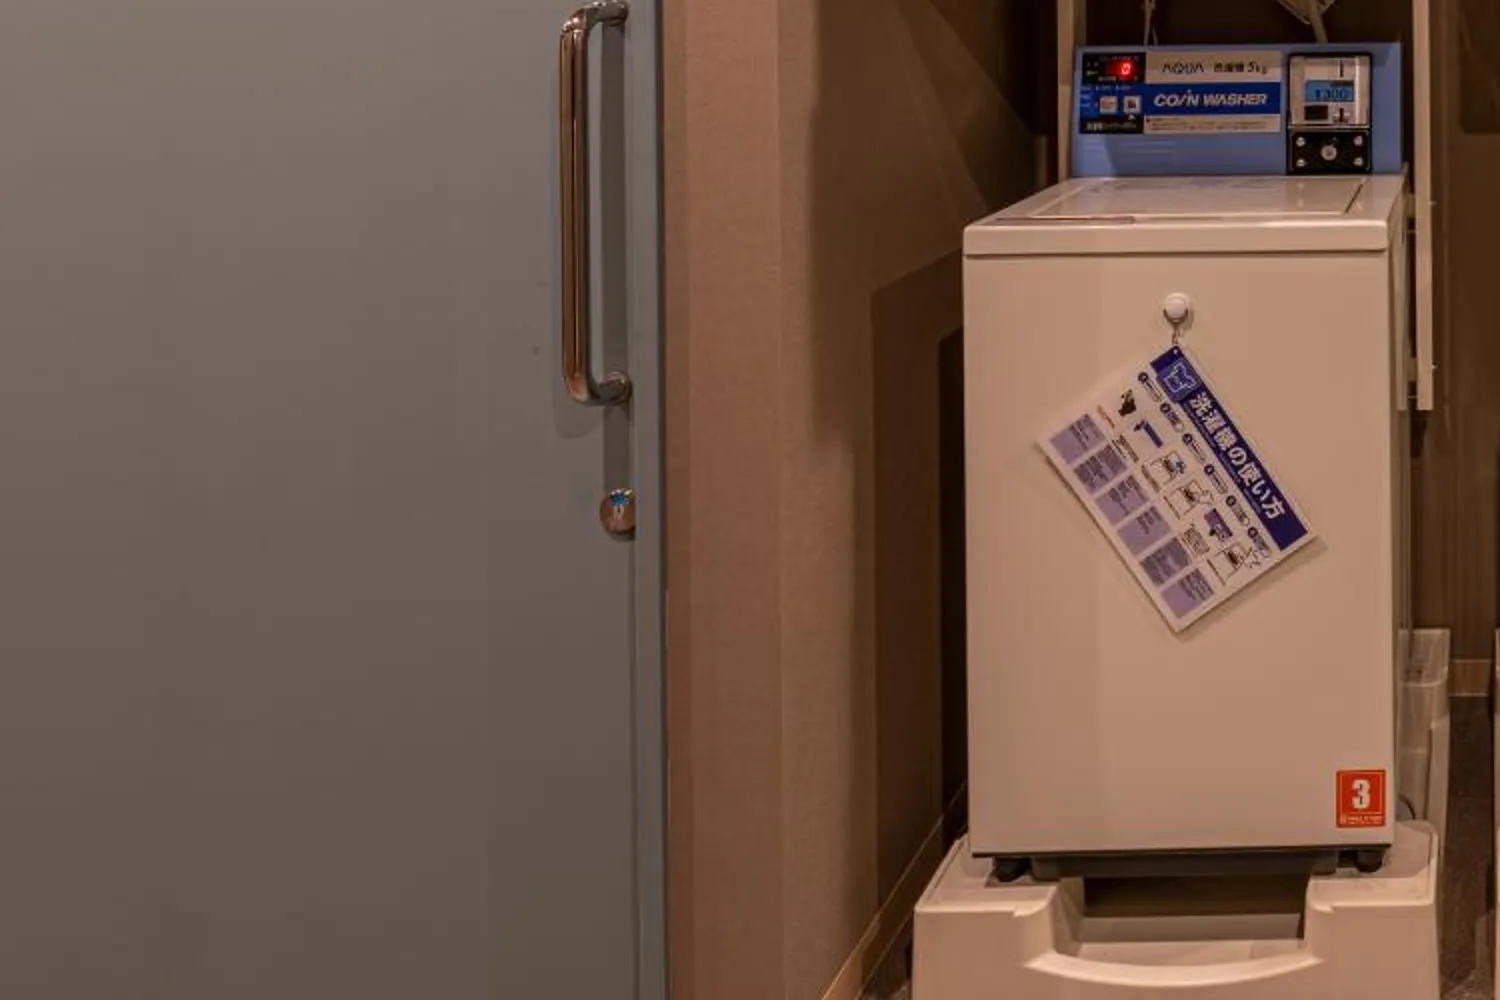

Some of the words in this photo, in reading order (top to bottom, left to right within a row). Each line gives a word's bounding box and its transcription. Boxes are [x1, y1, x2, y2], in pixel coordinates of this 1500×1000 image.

[1120, 62, 1131, 75] 0
[1162, 62, 1204, 74] AQUA
[1203, 93, 1268, 106] WASHER
[1191, 391, 1285, 520] 洗濯機の使い方
[1352, 779, 1371, 809] 3
